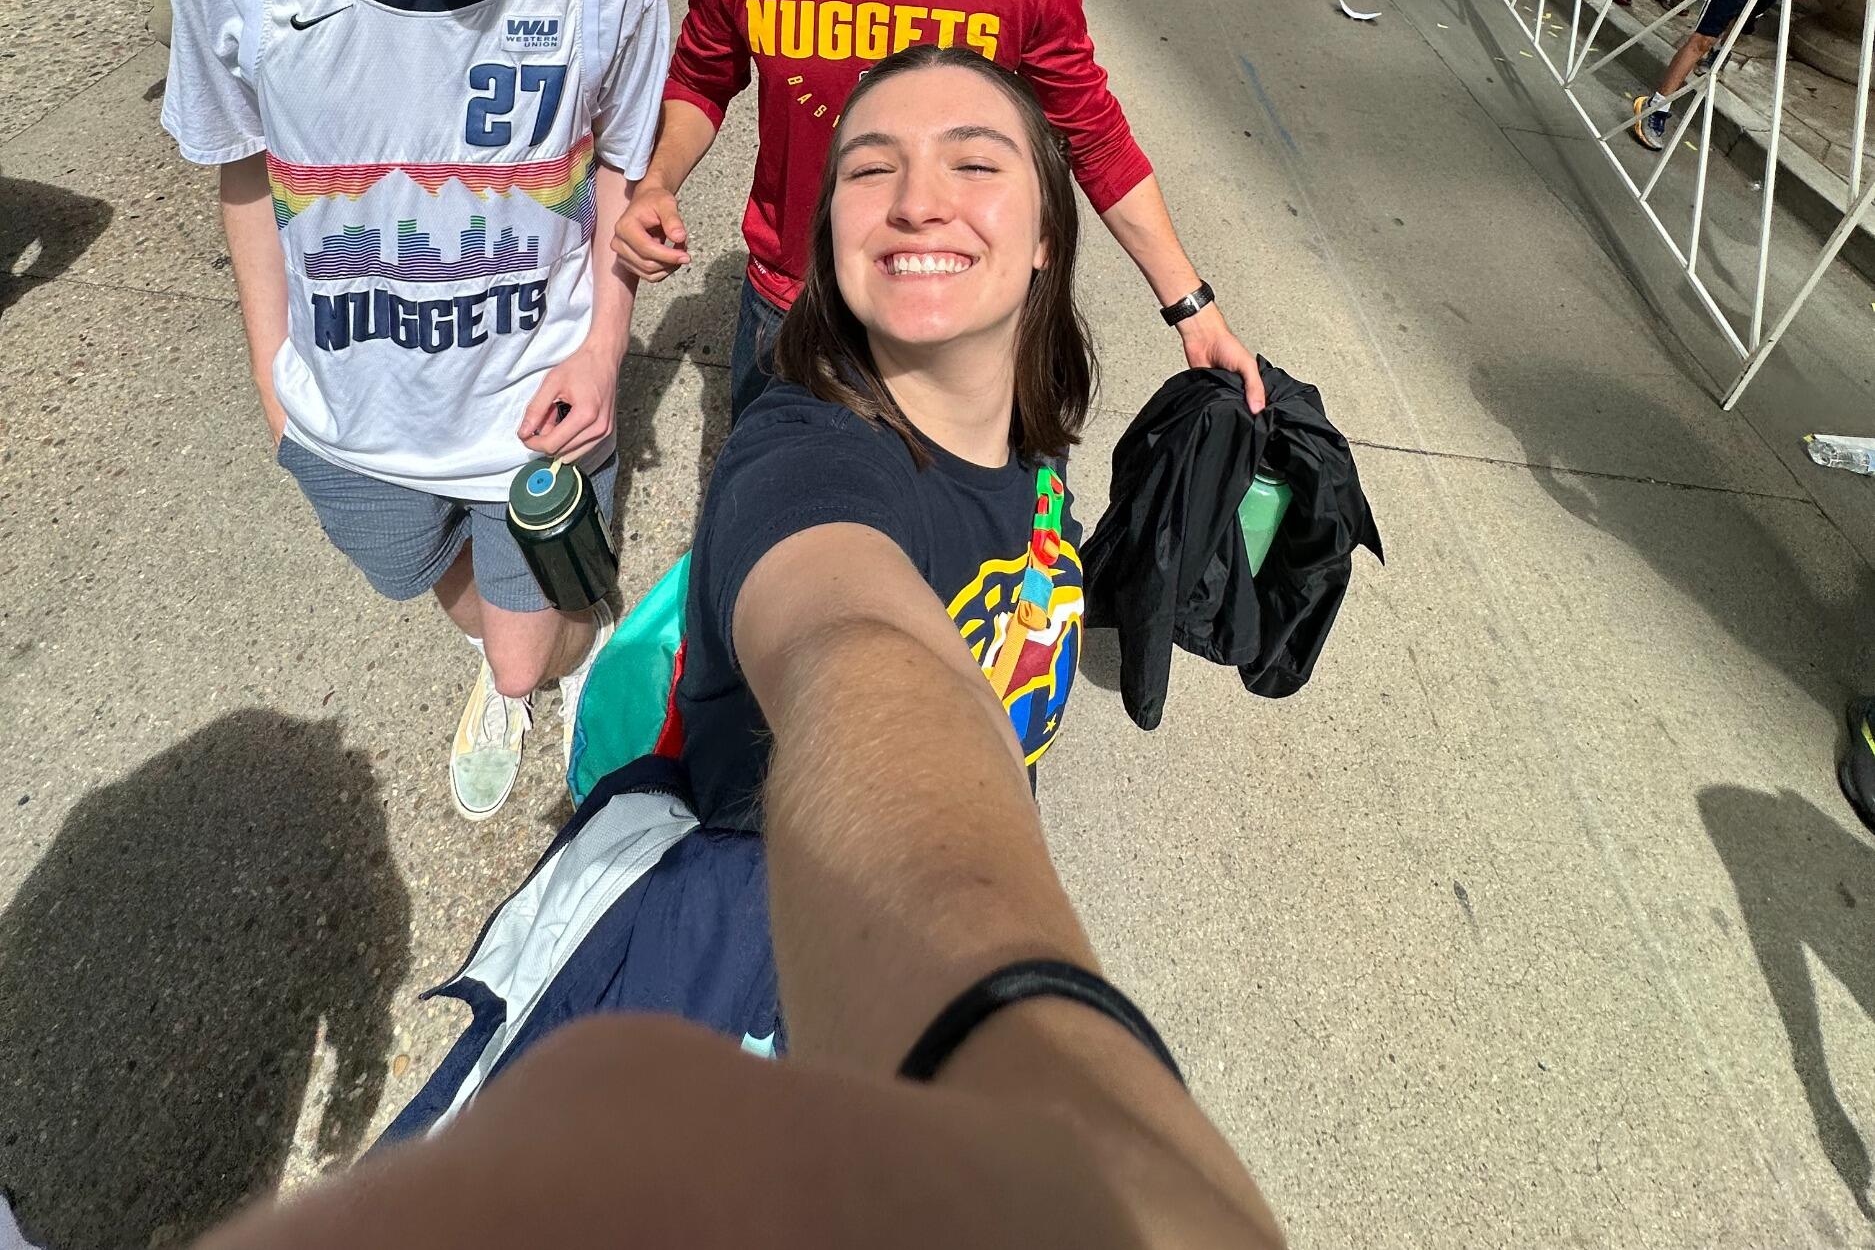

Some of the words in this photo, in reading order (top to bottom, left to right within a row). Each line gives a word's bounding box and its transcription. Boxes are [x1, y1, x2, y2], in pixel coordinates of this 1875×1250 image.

[507, 19, 559, 36] WU
[465, 62, 567, 148] 27
[310, 277, 549, 354] NUGGETS
